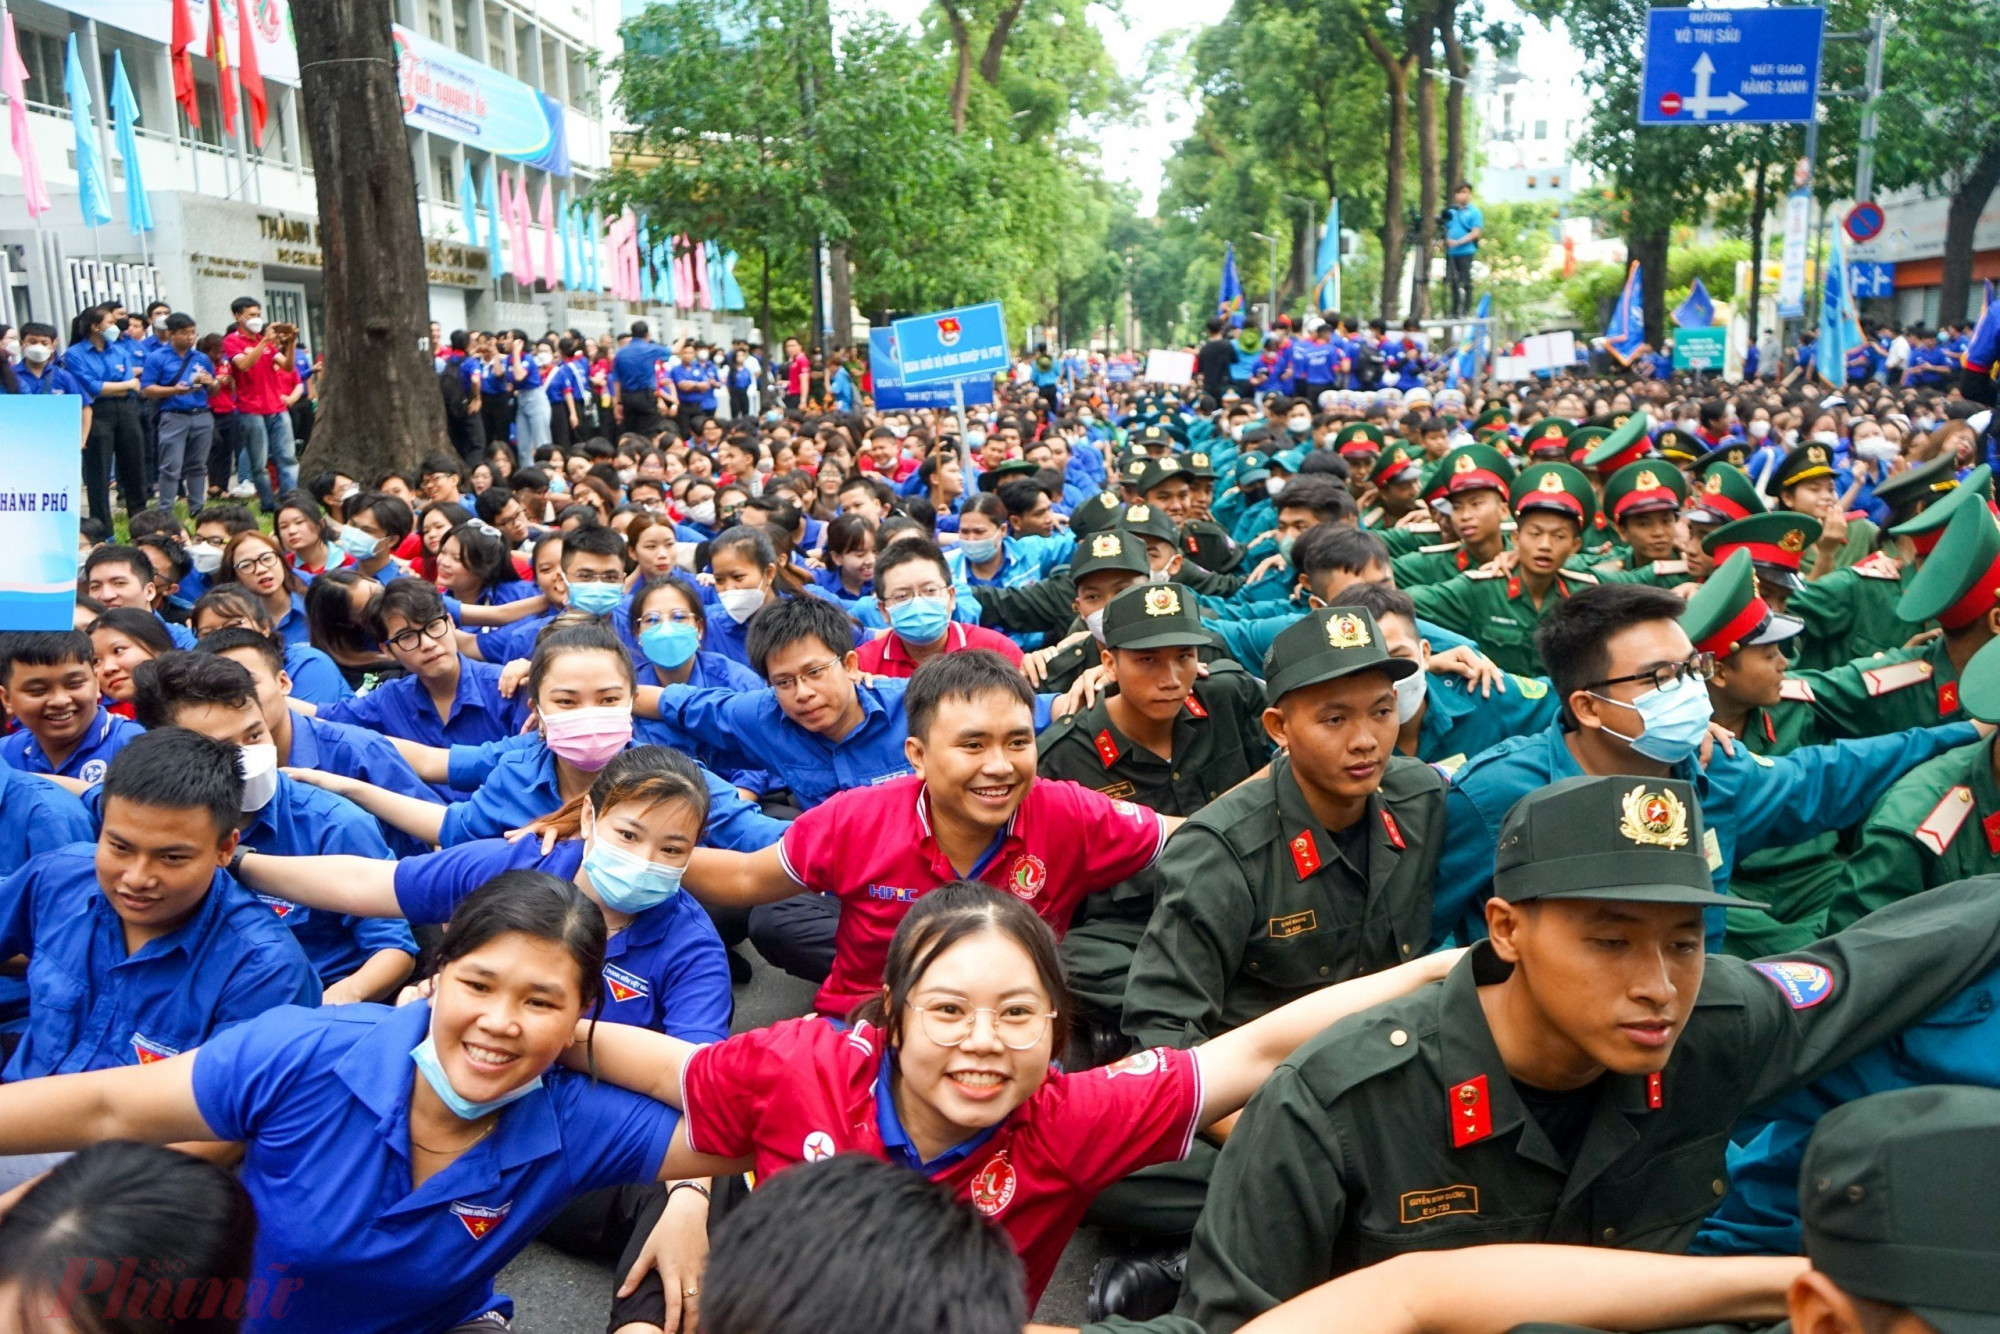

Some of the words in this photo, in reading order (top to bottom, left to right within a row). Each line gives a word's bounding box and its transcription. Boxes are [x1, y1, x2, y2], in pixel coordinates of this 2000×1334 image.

[1674, 26, 1693, 43] VÕ
[1694, 27, 1715, 45] THỊ
[1715, 25, 1741, 43] SÁU
[1751, 62, 1775, 75] NÚT
[1777, 63, 1806, 75] GIAO
[1741, 78, 1775, 94] HÀNG
[1776, 79, 1809, 94] XANH
[257, 211, 312, 245] THÀNH
[42, 485, 68, 511] PHỐ
